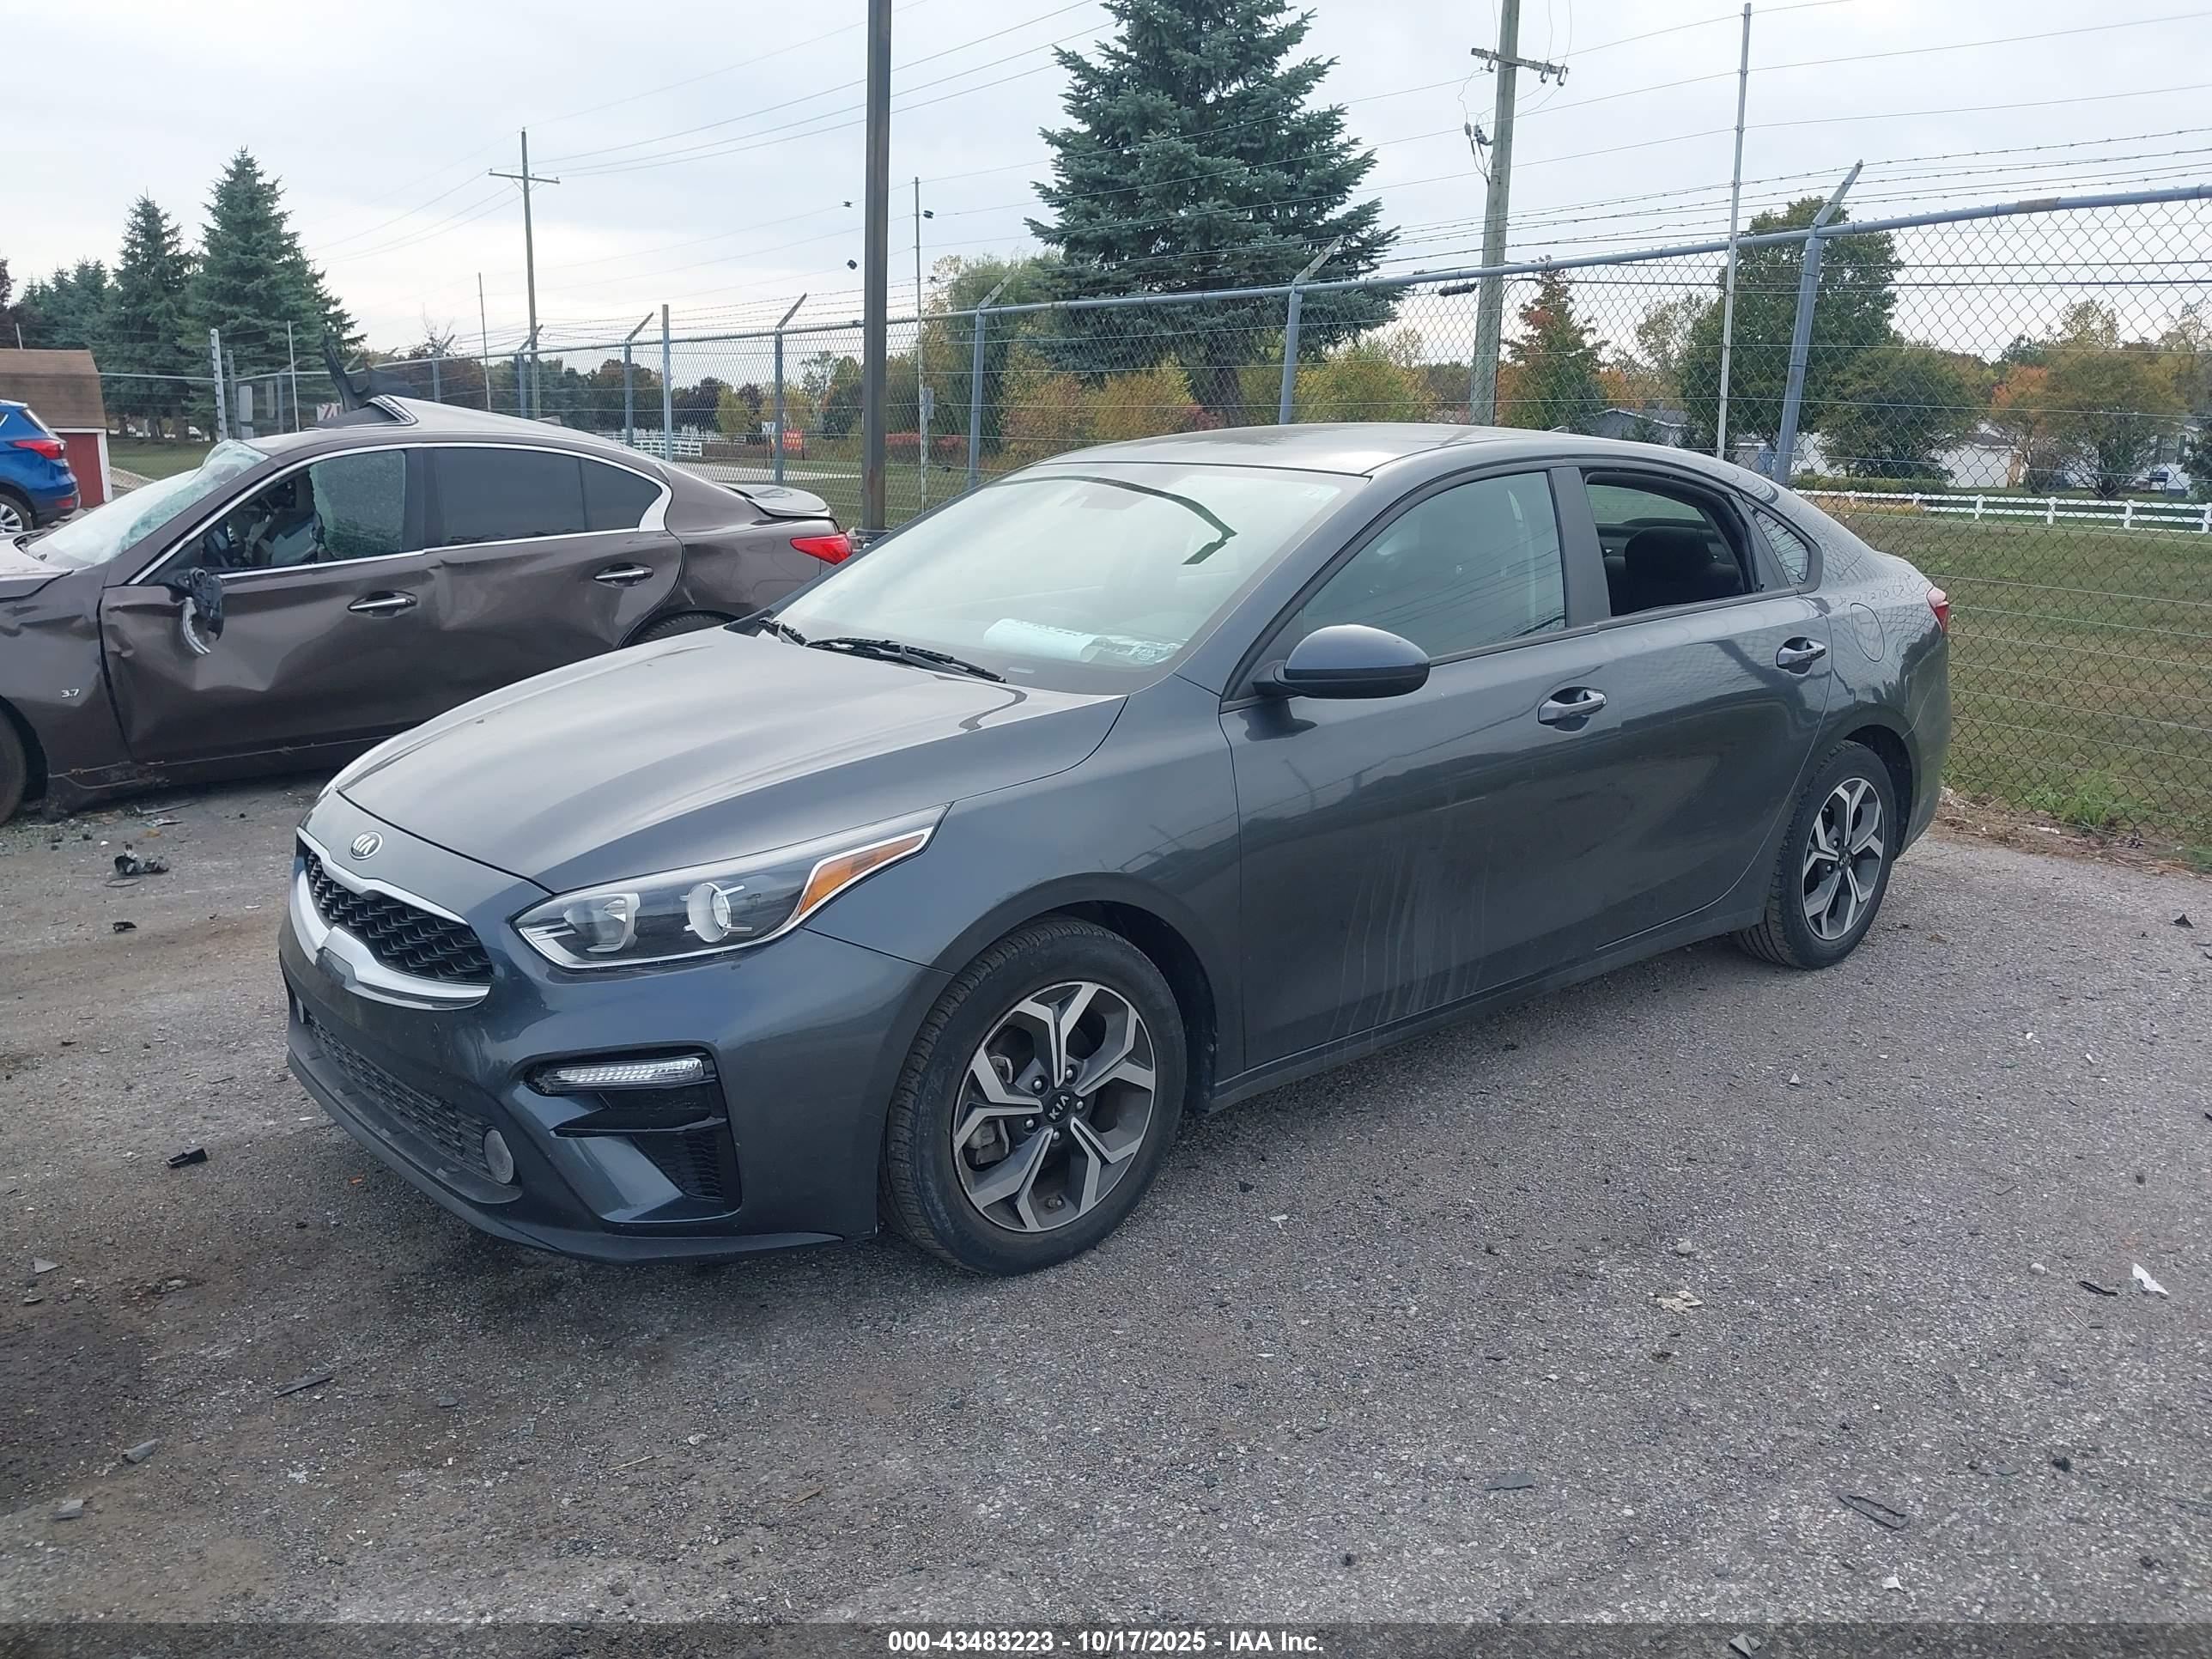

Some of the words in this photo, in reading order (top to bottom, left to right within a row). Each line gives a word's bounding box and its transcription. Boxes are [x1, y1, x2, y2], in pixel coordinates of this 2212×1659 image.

[61, 689, 79, 698] 3.7
[352, 833, 377, 855] KIA
[1048, 1095, 1070, 1121] KIA
